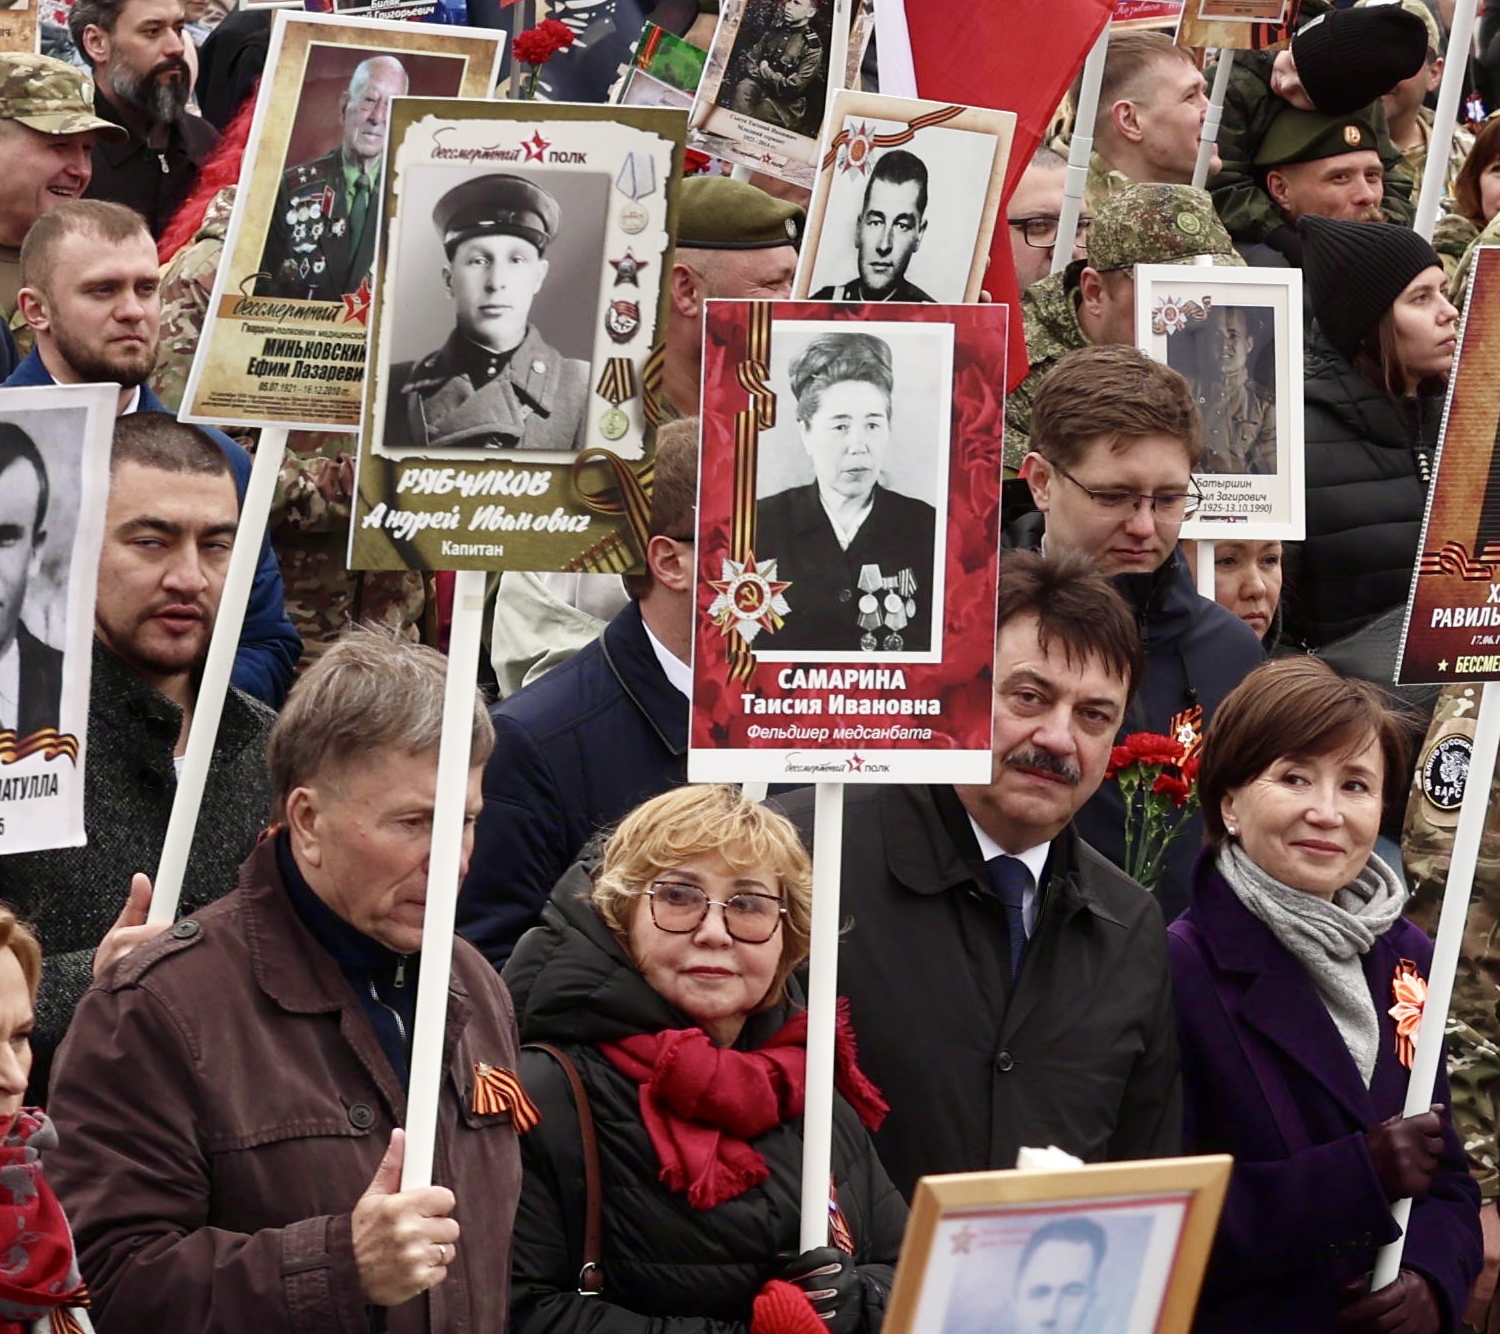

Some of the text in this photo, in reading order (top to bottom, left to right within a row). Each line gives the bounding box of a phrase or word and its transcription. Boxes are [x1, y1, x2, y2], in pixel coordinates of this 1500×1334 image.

[430, 127, 587, 165] бессмертный ПОЛК
[233, 272, 345, 324] бессмертный
[247, 356, 365, 383] Ефим Лазареви
[396, 468, 553, 497] РЯБЧИКОВ
[1196, 478, 1252, 491] Батыршин
[1217, 492, 1267, 504] Загирович
[362, 502, 591, 541] Андрей Иванович
[441, 541, 504, 556] Капитан
[778, 669, 907, 690] САМАРИНА
[741, 694, 941, 715] Таисия Ивановна
[747, 724, 933, 743] Фельдшер медсанбата
[864, 764, 891, 773] ПОЛК
